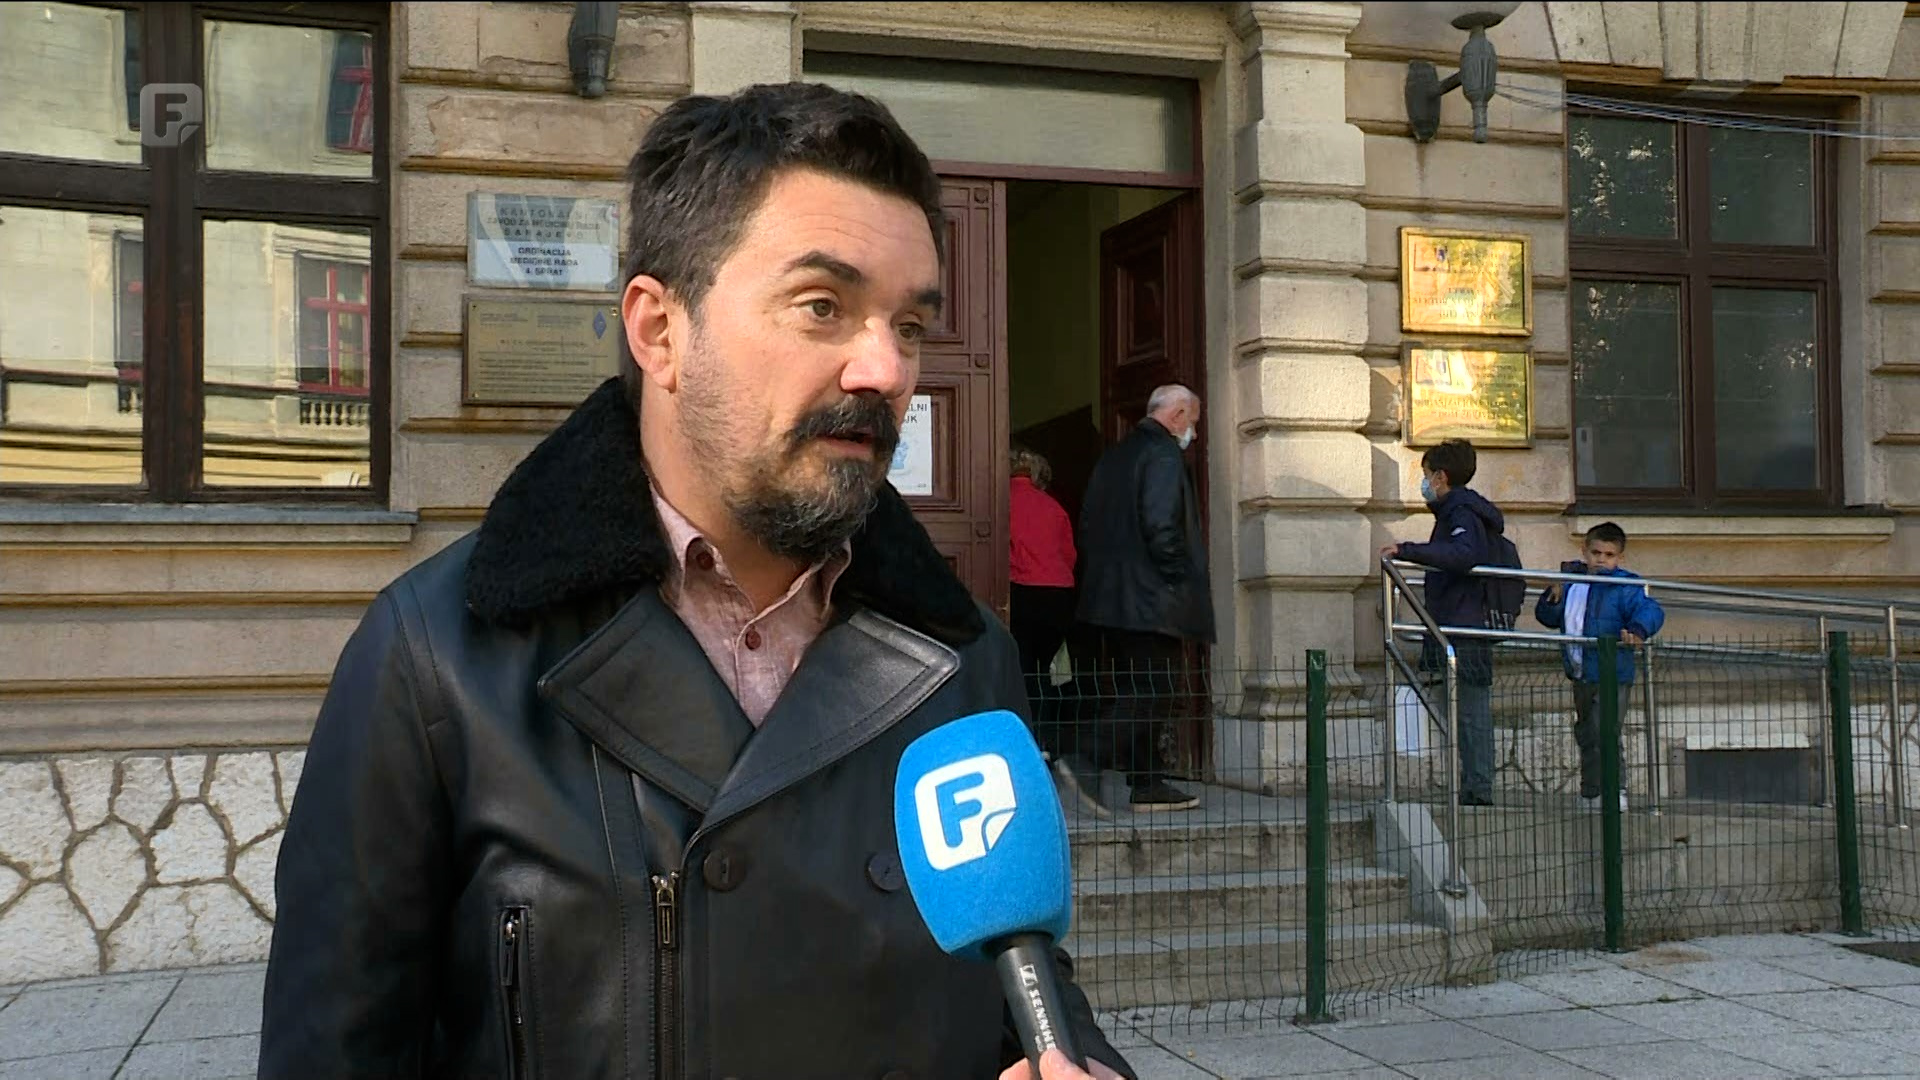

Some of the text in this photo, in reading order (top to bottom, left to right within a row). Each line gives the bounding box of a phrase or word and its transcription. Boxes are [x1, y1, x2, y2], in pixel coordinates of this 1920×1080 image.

[518, 246, 572, 256] ORDINACIJA
[554, 258, 579, 266] RADA
[1029, 988, 1057, 1050] SENNHE
